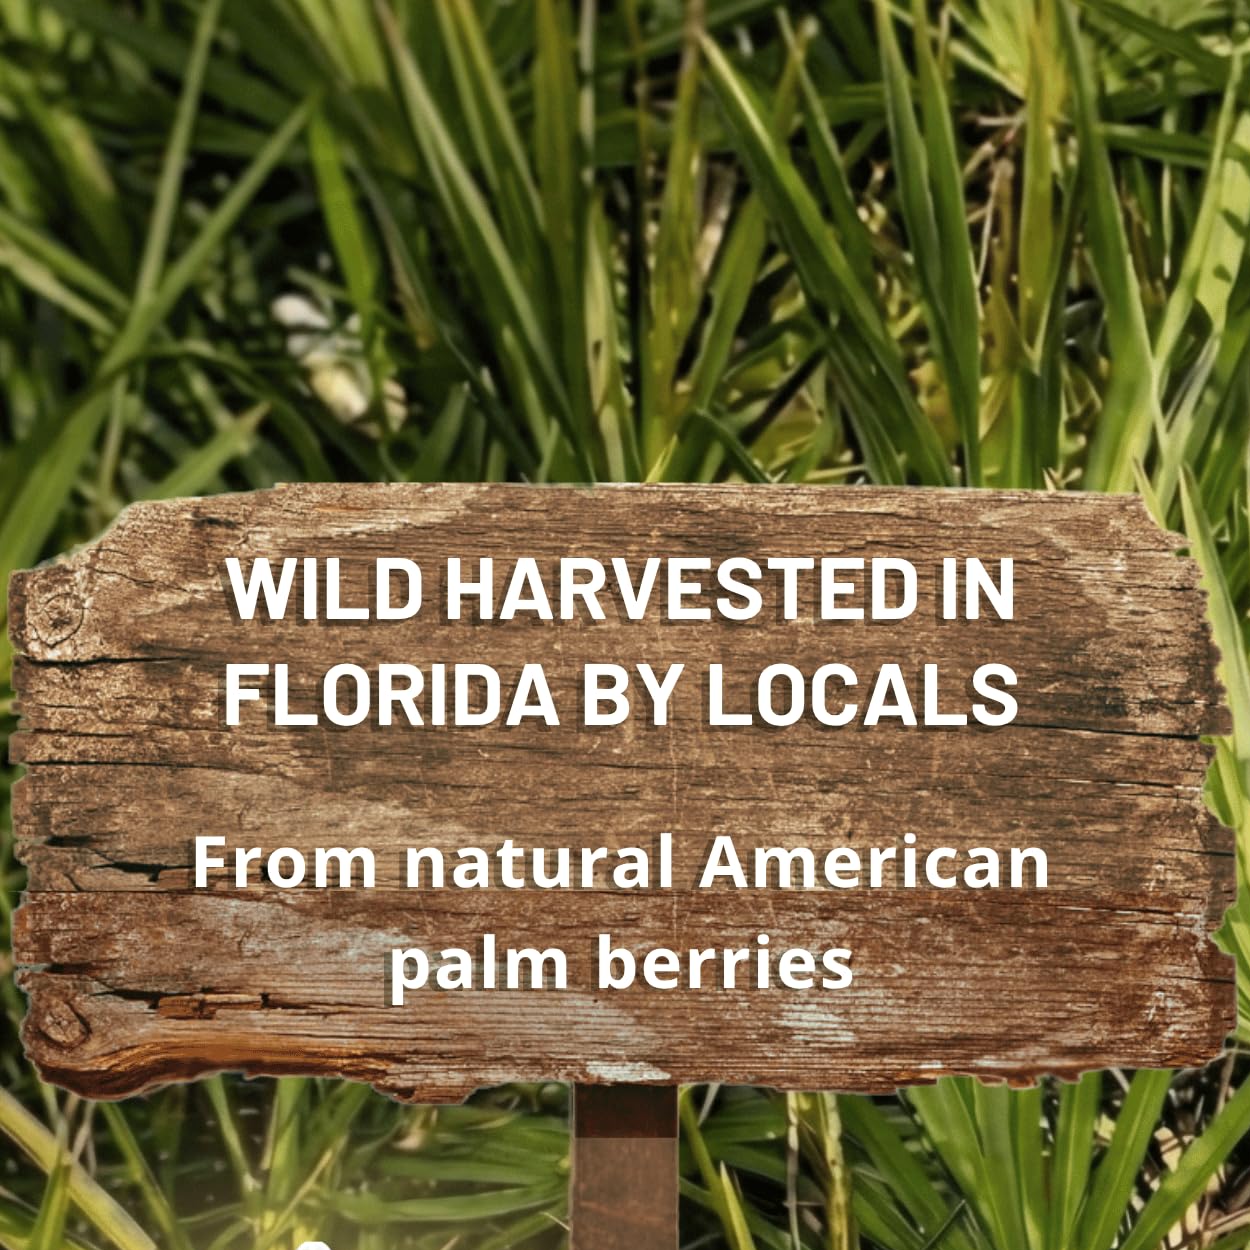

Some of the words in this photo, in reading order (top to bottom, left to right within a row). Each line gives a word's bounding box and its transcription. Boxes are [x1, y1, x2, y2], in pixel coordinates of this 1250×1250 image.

[225, 557, 422, 620] WILD
[447, 557, 918, 620] HARVESTED
[943, 557, 1014, 620] IN
[226, 663, 560, 726] FLORIDA
[584, 663, 685, 726] BY
[709, 663, 1018, 727] LOCALS
[195, 836, 375, 888] From
[407, 832, 672, 888] natural
[699, 833, 1048, 888] American
[392, 933, 567, 1006] palm
[599, 934, 853, 989] berries
